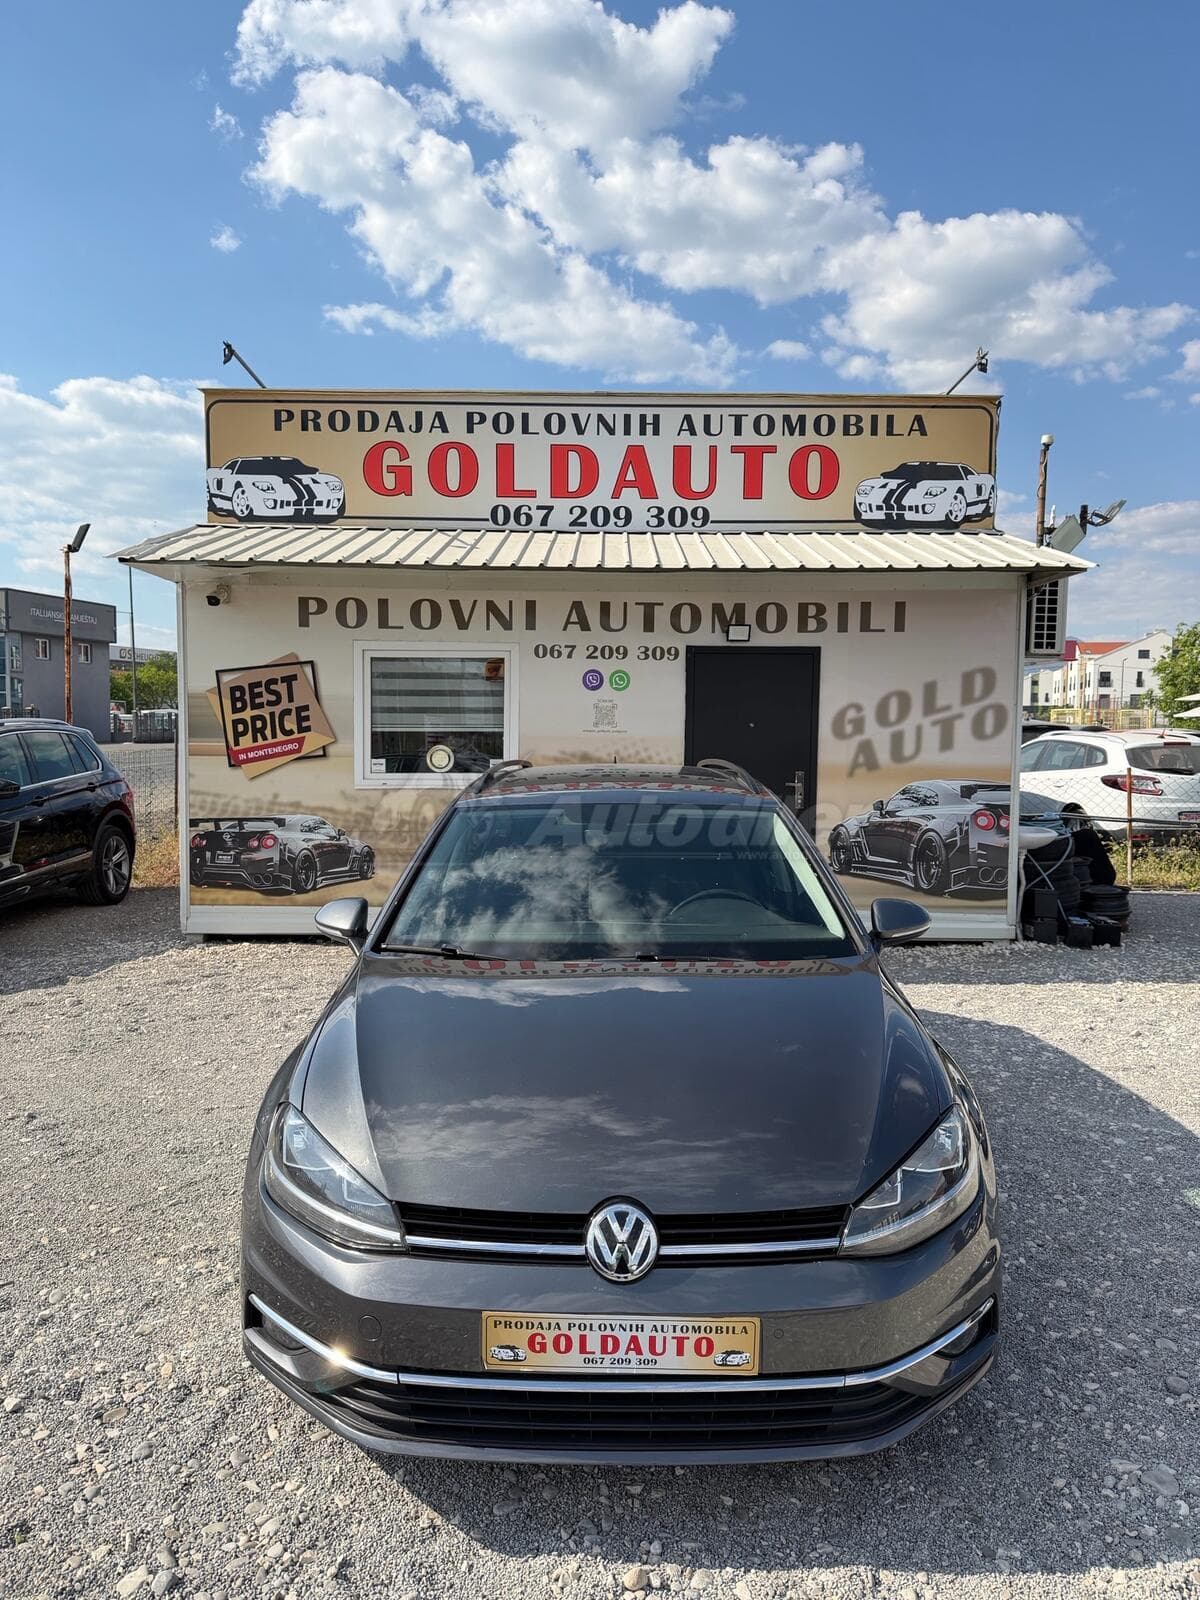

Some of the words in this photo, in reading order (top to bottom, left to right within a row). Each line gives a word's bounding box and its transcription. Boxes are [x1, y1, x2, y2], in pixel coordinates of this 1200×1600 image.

[274, 408, 450, 434] PRODAJA
[466, 411, 661, 437] POLOVNIH
[676, 413, 929, 437] AUTOMOBILA
[362, 440, 840, 501] GOLDAUTO
[490, 504, 555, 528] 067
[568, 506, 633, 528] 209
[646, 506, 711, 529] 309
[297, 596, 537, 631] POLOVNI
[562, 600, 907, 634] AUTOMOBILI
[533, 643, 577, 659] 067
[585, 644, 629, 660] 209
[636, 645, 680, 661] 309
[229, 673, 298, 714] BEST
[831, 666, 997, 741] GOLD
[231, 704, 312, 747] PRICE
[248, 742, 299, 758] MONTENEGRO
[847, 702, 1009, 779] AUTO
[493, 1319, 562, 1332] PRODAJA
[567, 1321, 645, 1333] POLOVNIH
[650, 1324, 750, 1335] AUTOMOBILA
[527, 1332, 715, 1358] GOLDAUTO
[583, 1356, 608, 1366] 067
[609, 1357, 632, 1367] 209
[635, 1358, 659, 1368] 309
